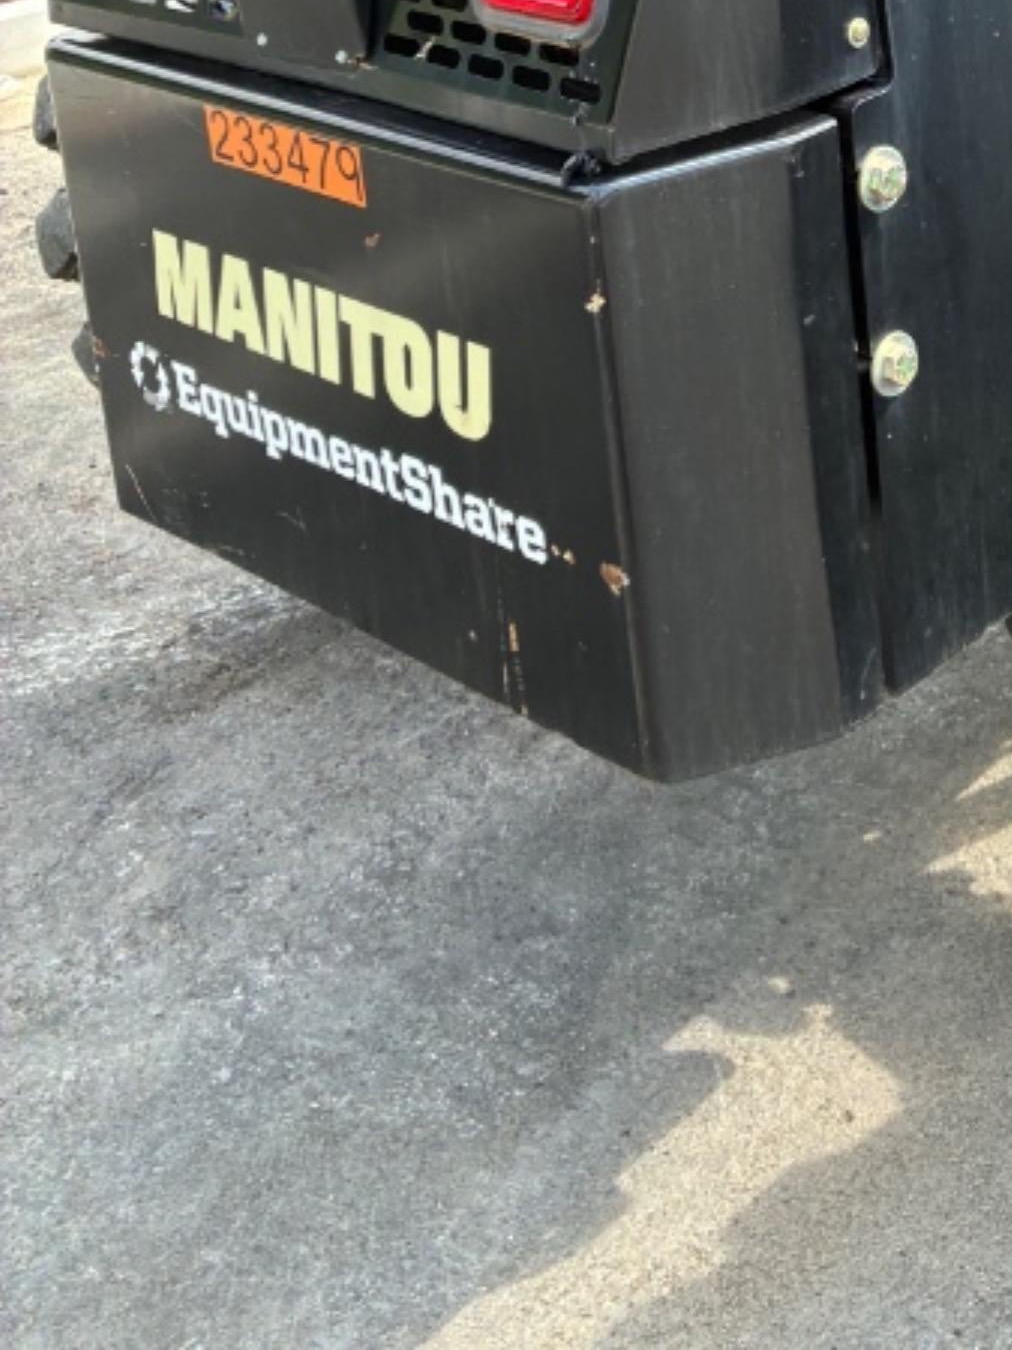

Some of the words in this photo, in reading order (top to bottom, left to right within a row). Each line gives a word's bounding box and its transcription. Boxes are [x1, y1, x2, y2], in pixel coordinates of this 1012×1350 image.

[209, 109, 364, 202] 233479
[152, 228, 492, 441] MANITOU
[171, 360, 548, 565] EquipmentShare
